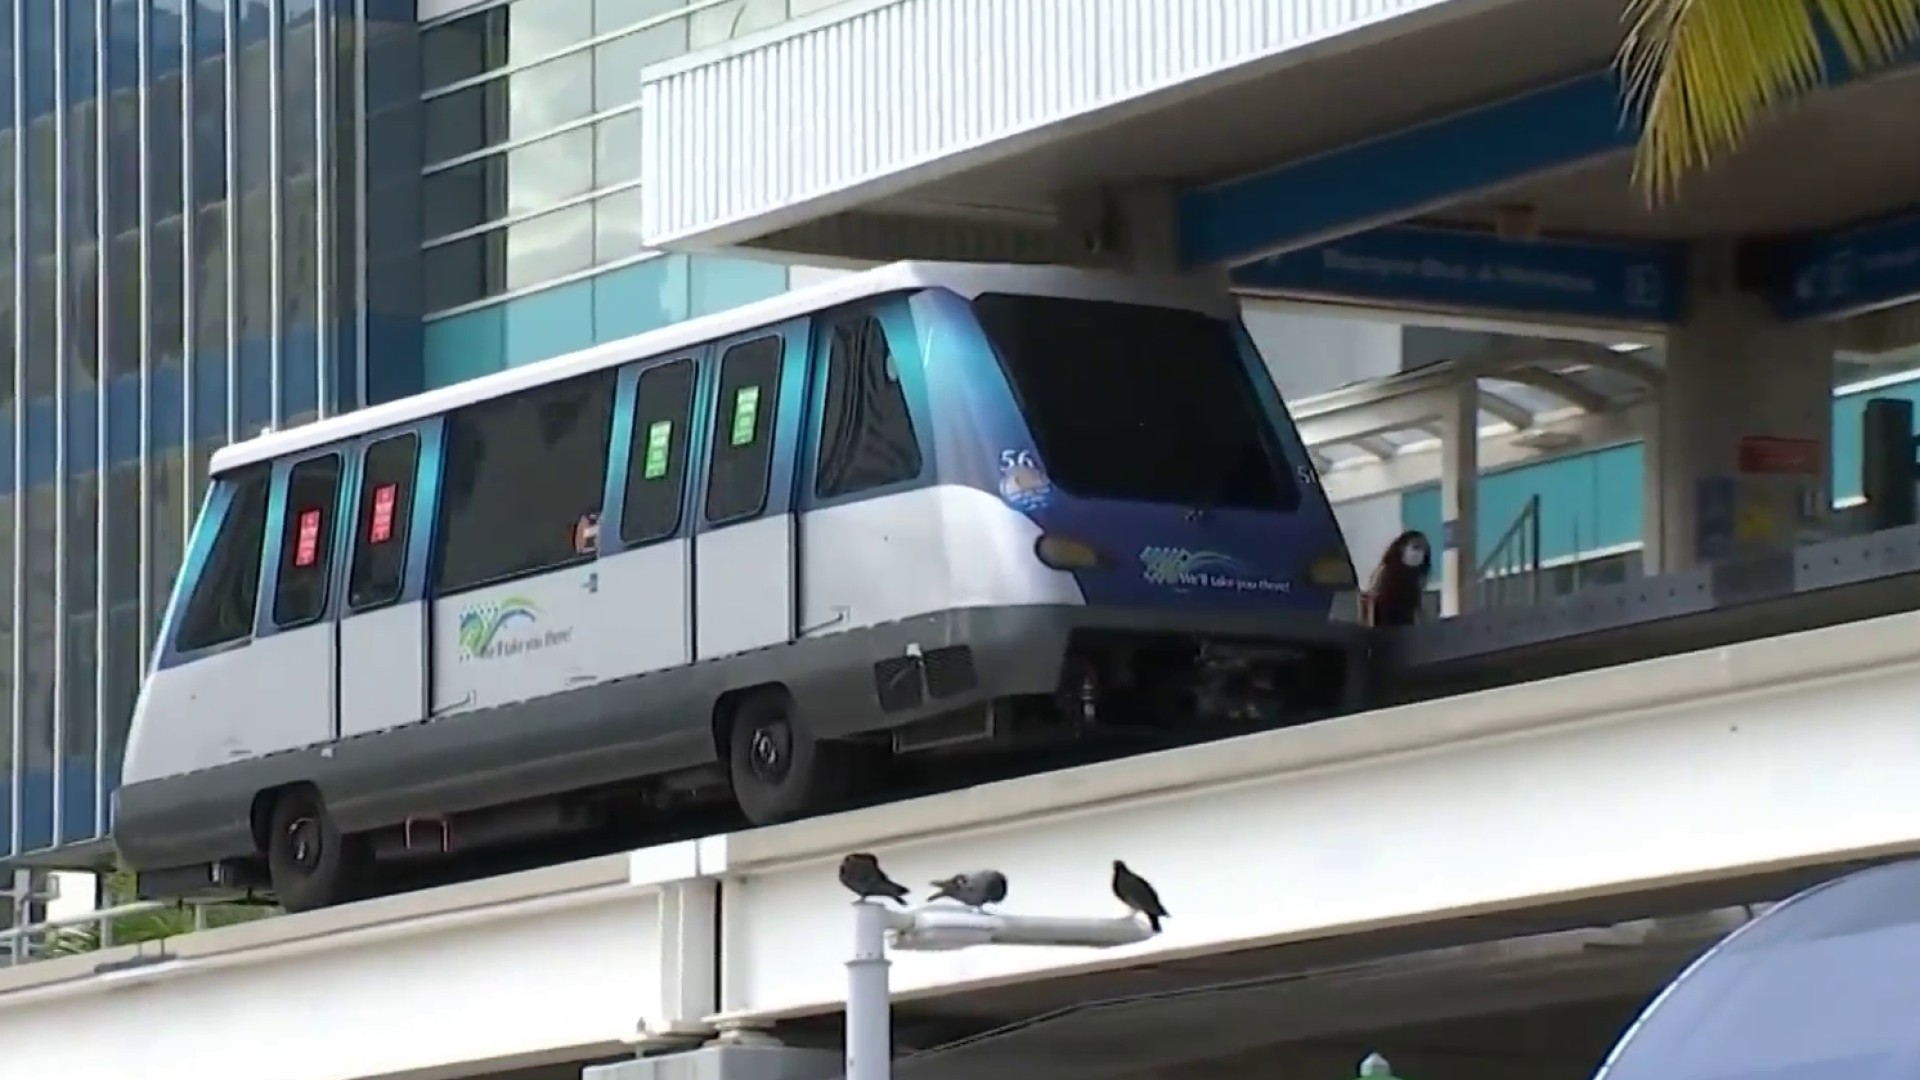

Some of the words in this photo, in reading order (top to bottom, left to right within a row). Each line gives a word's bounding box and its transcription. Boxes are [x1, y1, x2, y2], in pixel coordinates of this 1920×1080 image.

[1000, 448, 1034, 470] 56
[1178, 571, 1208, 587] We'll
[1210, 575, 1235, 588] take
[1237, 579, 1257, 593] you
